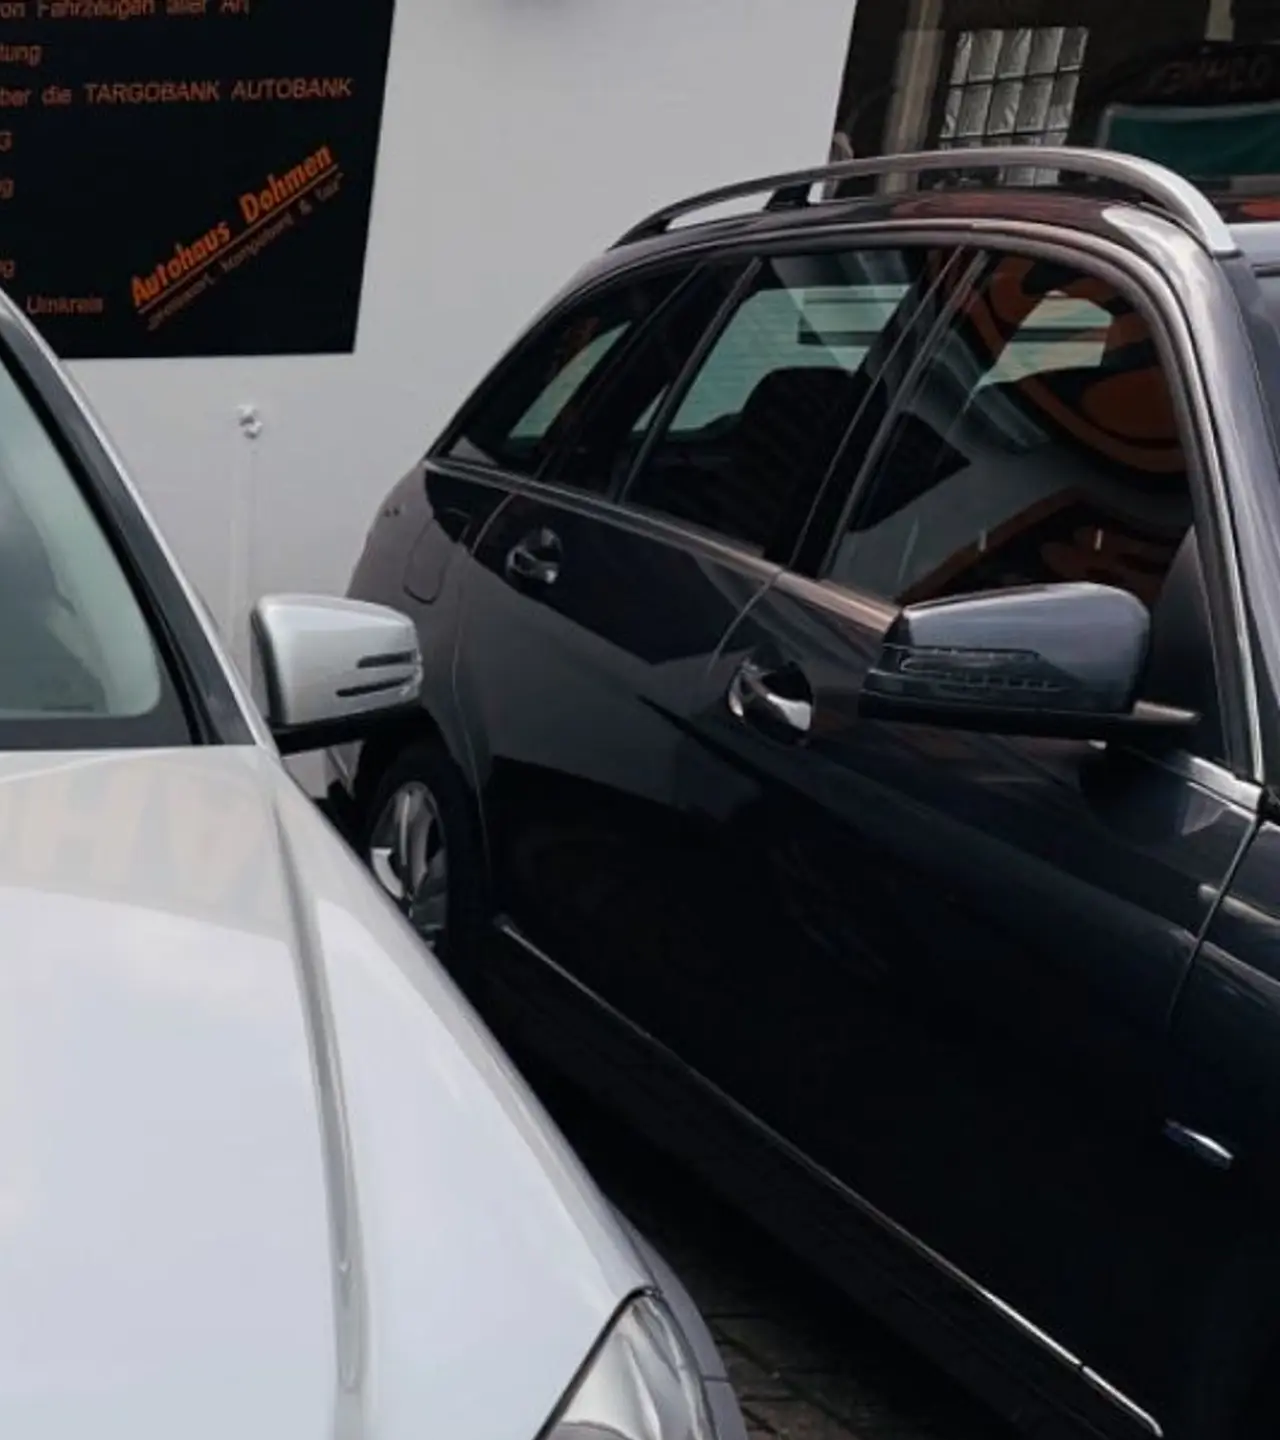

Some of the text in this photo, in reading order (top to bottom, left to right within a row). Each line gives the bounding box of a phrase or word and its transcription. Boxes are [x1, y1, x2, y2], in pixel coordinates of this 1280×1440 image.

[37, 0, 156, 20] Fahrzeugen
[42, 84, 73, 106] die
[83, 80, 221, 105] TARGOBANK
[230, 77, 353, 100] AUTOBANK
[130, 220, 231, 307] Autohaus
[239, 145, 333, 224] Dohmen
